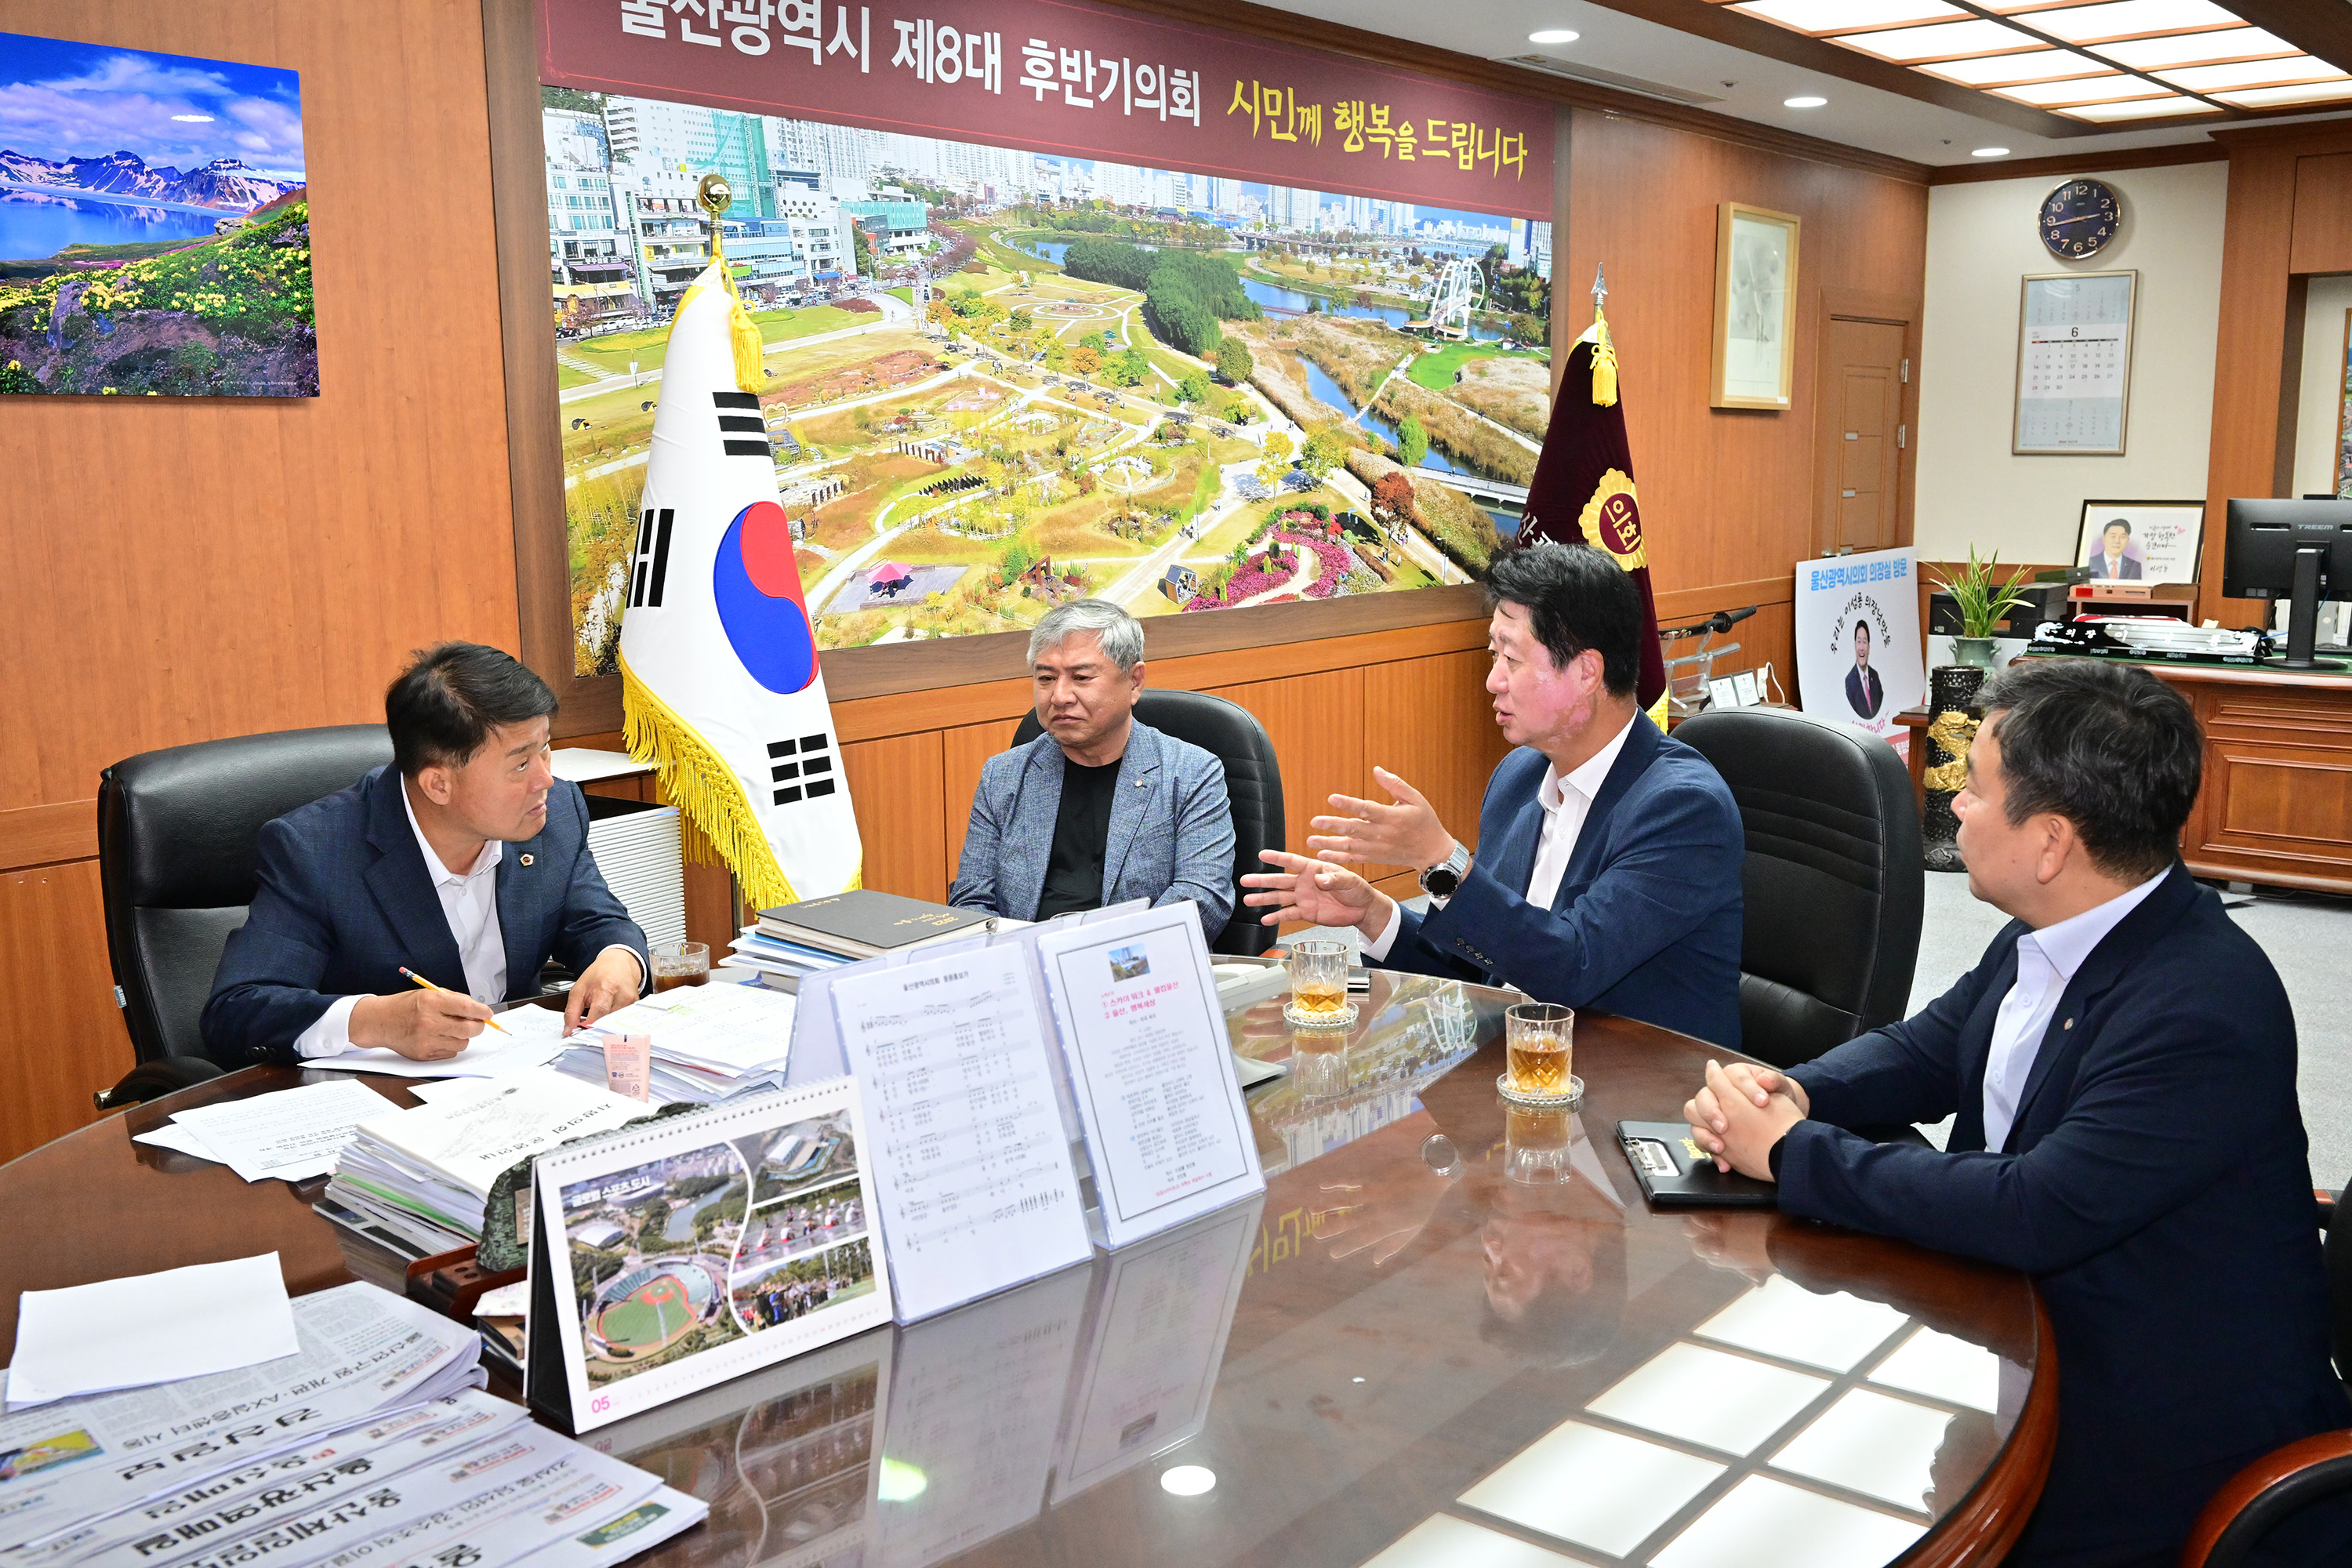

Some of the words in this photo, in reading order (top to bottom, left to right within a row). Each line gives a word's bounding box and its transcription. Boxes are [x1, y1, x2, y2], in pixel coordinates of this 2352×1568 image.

[891, 20, 1001, 94] 제8대
[1020, 38, 1200, 126] 후반기의회
[1228, 81, 1321, 147] 시민께
[1333, 101, 1417, 161] 행복을
[1422, 119, 1527, 181] 드립니다
[2075, 185, 2088, 195] 12
[2093, 188, 2097, 198] 1
[2063, 191, 2071, 201] 11
[2052, 202, 2063, 212] 10
[2101, 198, 2111, 209] 2
[2046, 216, 2056, 226] 9
[2104, 212, 2114, 221] 3
[2050, 230, 2060, 240] 8
[2097, 227, 2107, 236] 4
[2060, 239, 2070, 249] 7
[2073, 242, 2083, 252] 6
[2088, 237, 2097, 247] 5
[2071, 326, 2078, 338] 6
[1605, 500, 1641, 552] 의회
[1811, 564, 1867, 591] 울산광역시의회
[1870, 560, 1891, 582] 의장실
[1893, 557, 1907, 578] 방문
[1831, 615, 1846, 654] 우리는
[1110, 995, 1130, 1007] 스카이
[591, 1395, 610, 1414] 05
[132, 1457, 373, 1557] 울산광역매일
